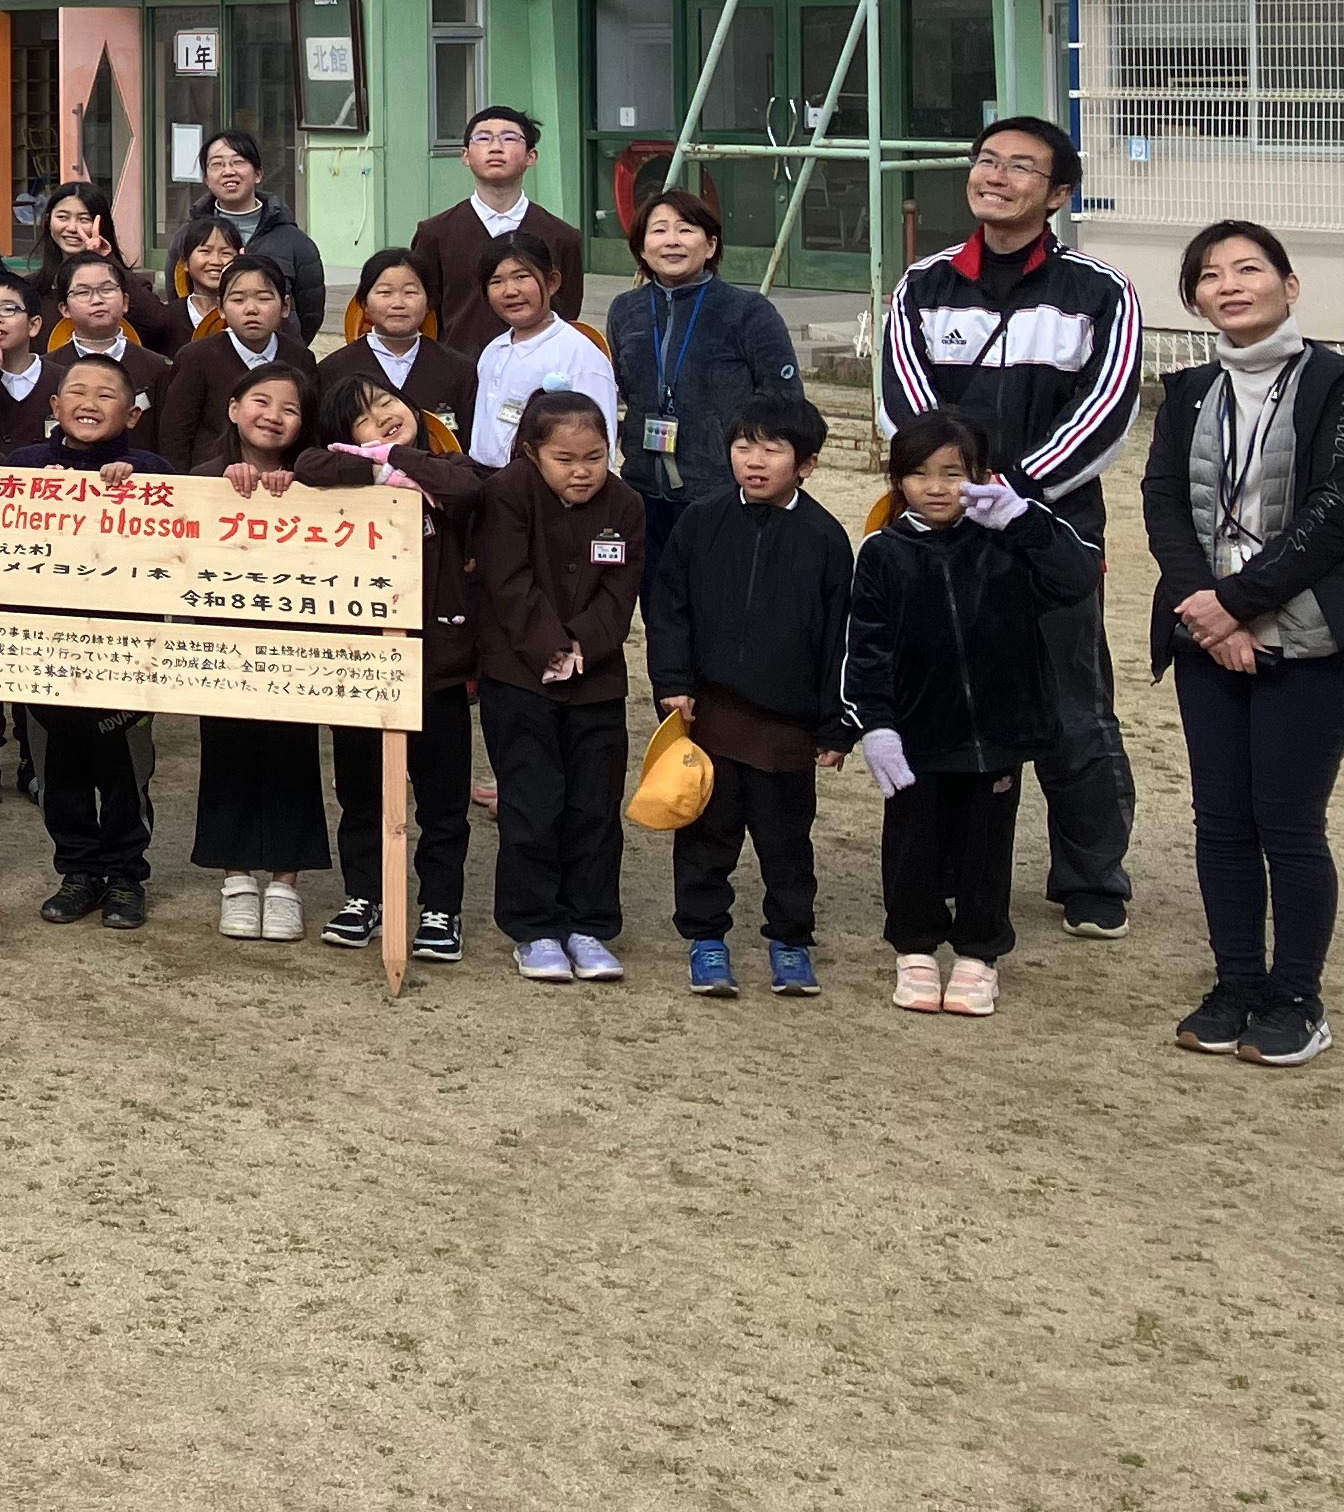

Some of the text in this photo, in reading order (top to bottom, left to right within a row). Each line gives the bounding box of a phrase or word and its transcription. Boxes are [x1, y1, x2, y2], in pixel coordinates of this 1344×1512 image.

[185, 44, 213, 71] 1年
[313, 44, 349, 73] 北館
[1, 503, 383, 550] Cherry blossom プロジェクト
[180, 589, 388, 619] 令和8年3月10日
[98, 711, 136, 734] ADVA
